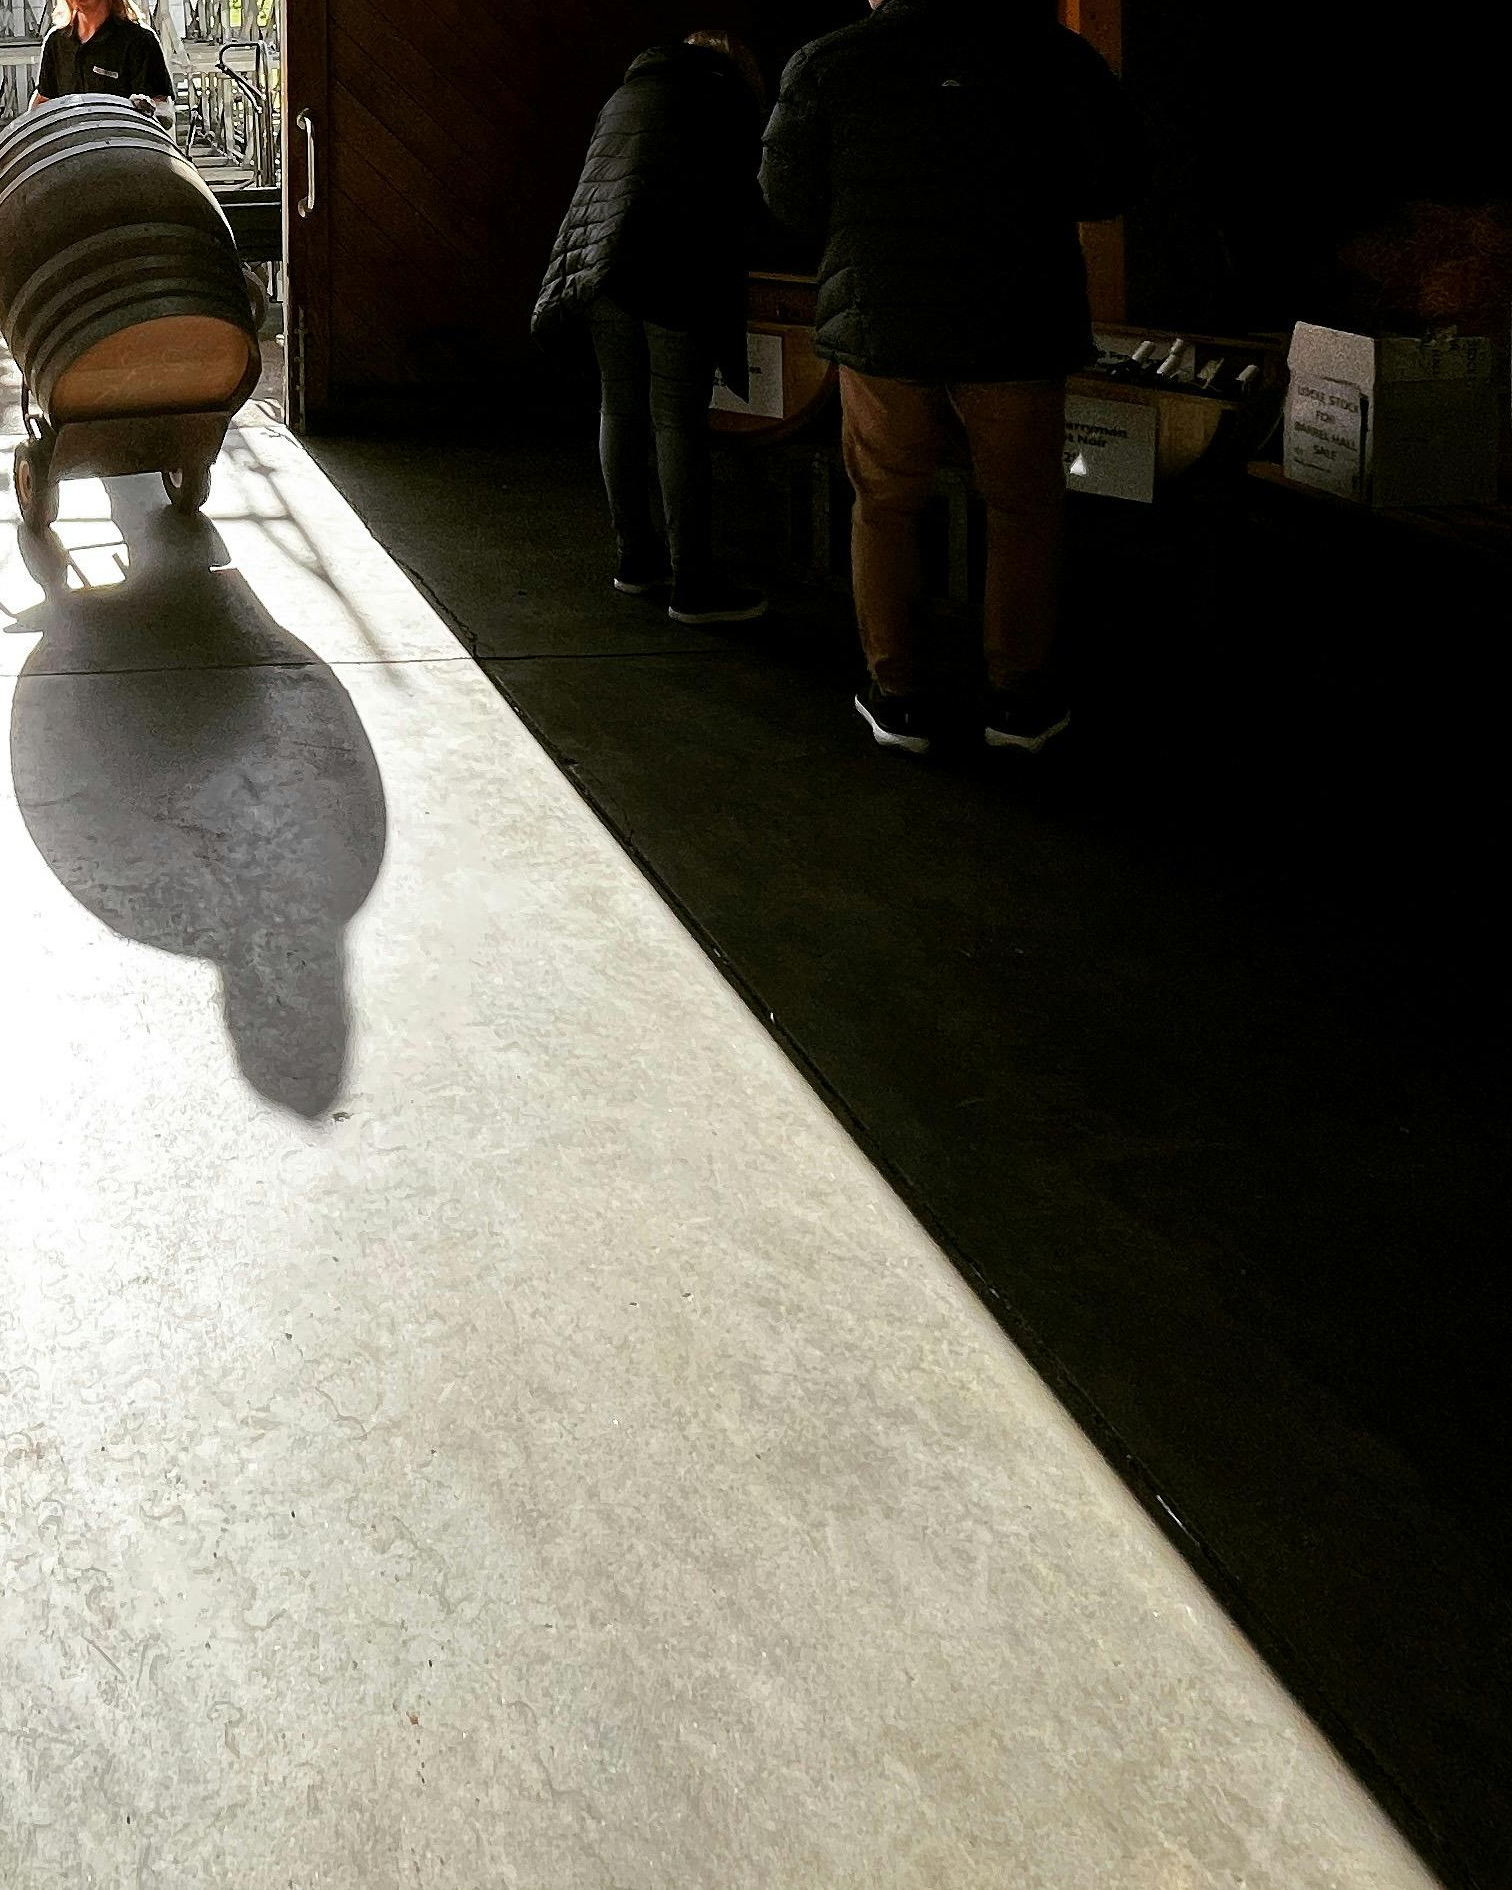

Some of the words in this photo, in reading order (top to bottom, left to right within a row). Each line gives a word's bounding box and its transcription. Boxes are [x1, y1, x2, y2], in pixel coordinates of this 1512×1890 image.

[1329, 395, 1358, 414] STOCK
[1316, 411, 1336, 424] FOR
[1078, 435, 1107, 447] Noir
[1295, 421, 1329, 441] BARREL
[1331, 432, 1357, 450] HALL
[1313, 445, 1337, 461] SALE
